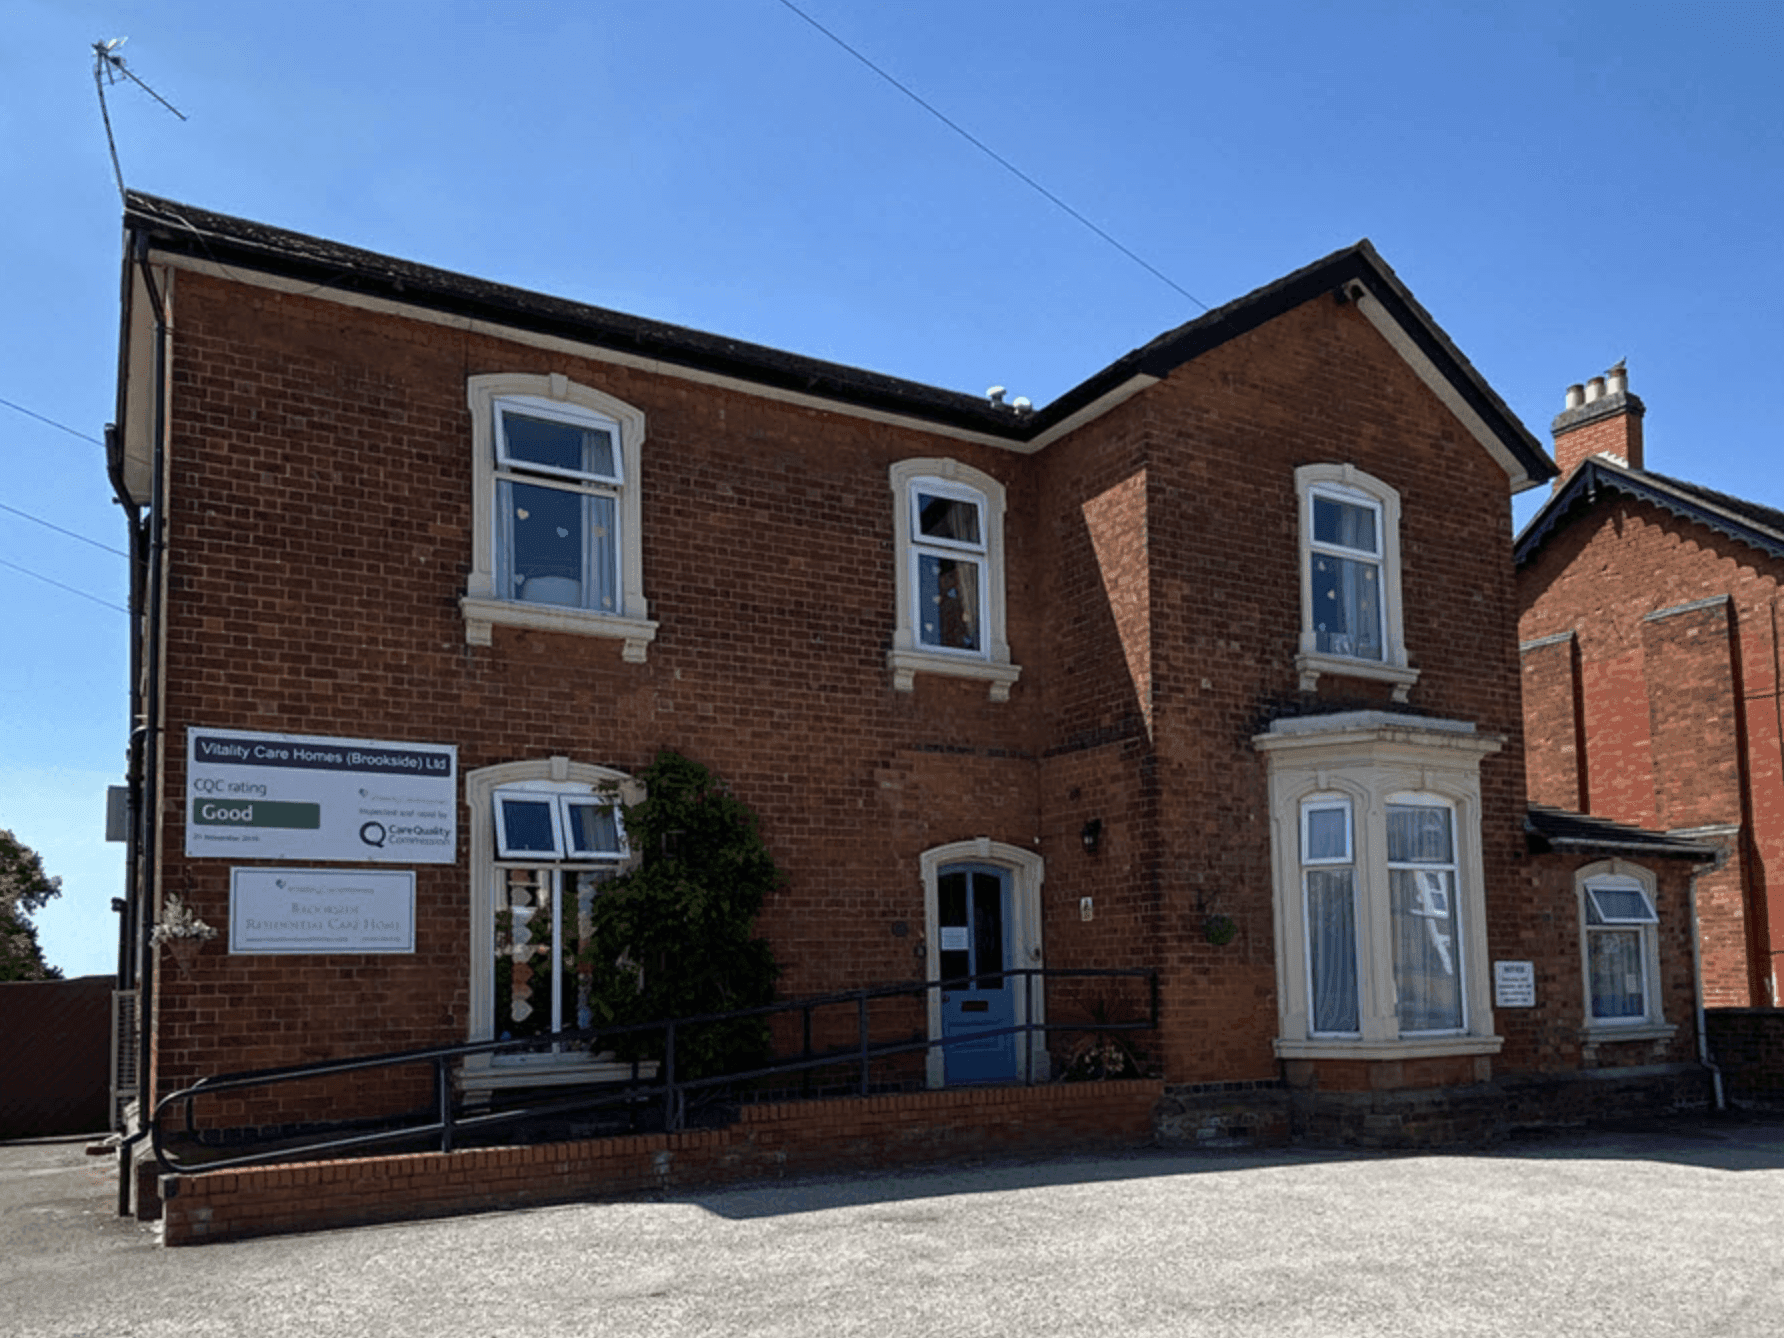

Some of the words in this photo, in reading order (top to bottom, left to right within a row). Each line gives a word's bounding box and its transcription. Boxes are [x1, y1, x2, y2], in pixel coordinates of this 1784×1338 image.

[201, 741, 250, 760] Vitality
[254, 745, 289, 760] Care
[293, 748, 342, 763] Homes
[346, 752, 423, 770] (Brookside)
[426, 757, 446, 770] Ltd
[193, 778, 224, 793] CQC
[228, 782, 267, 797] rating
[201, 804, 253, 822] Good
